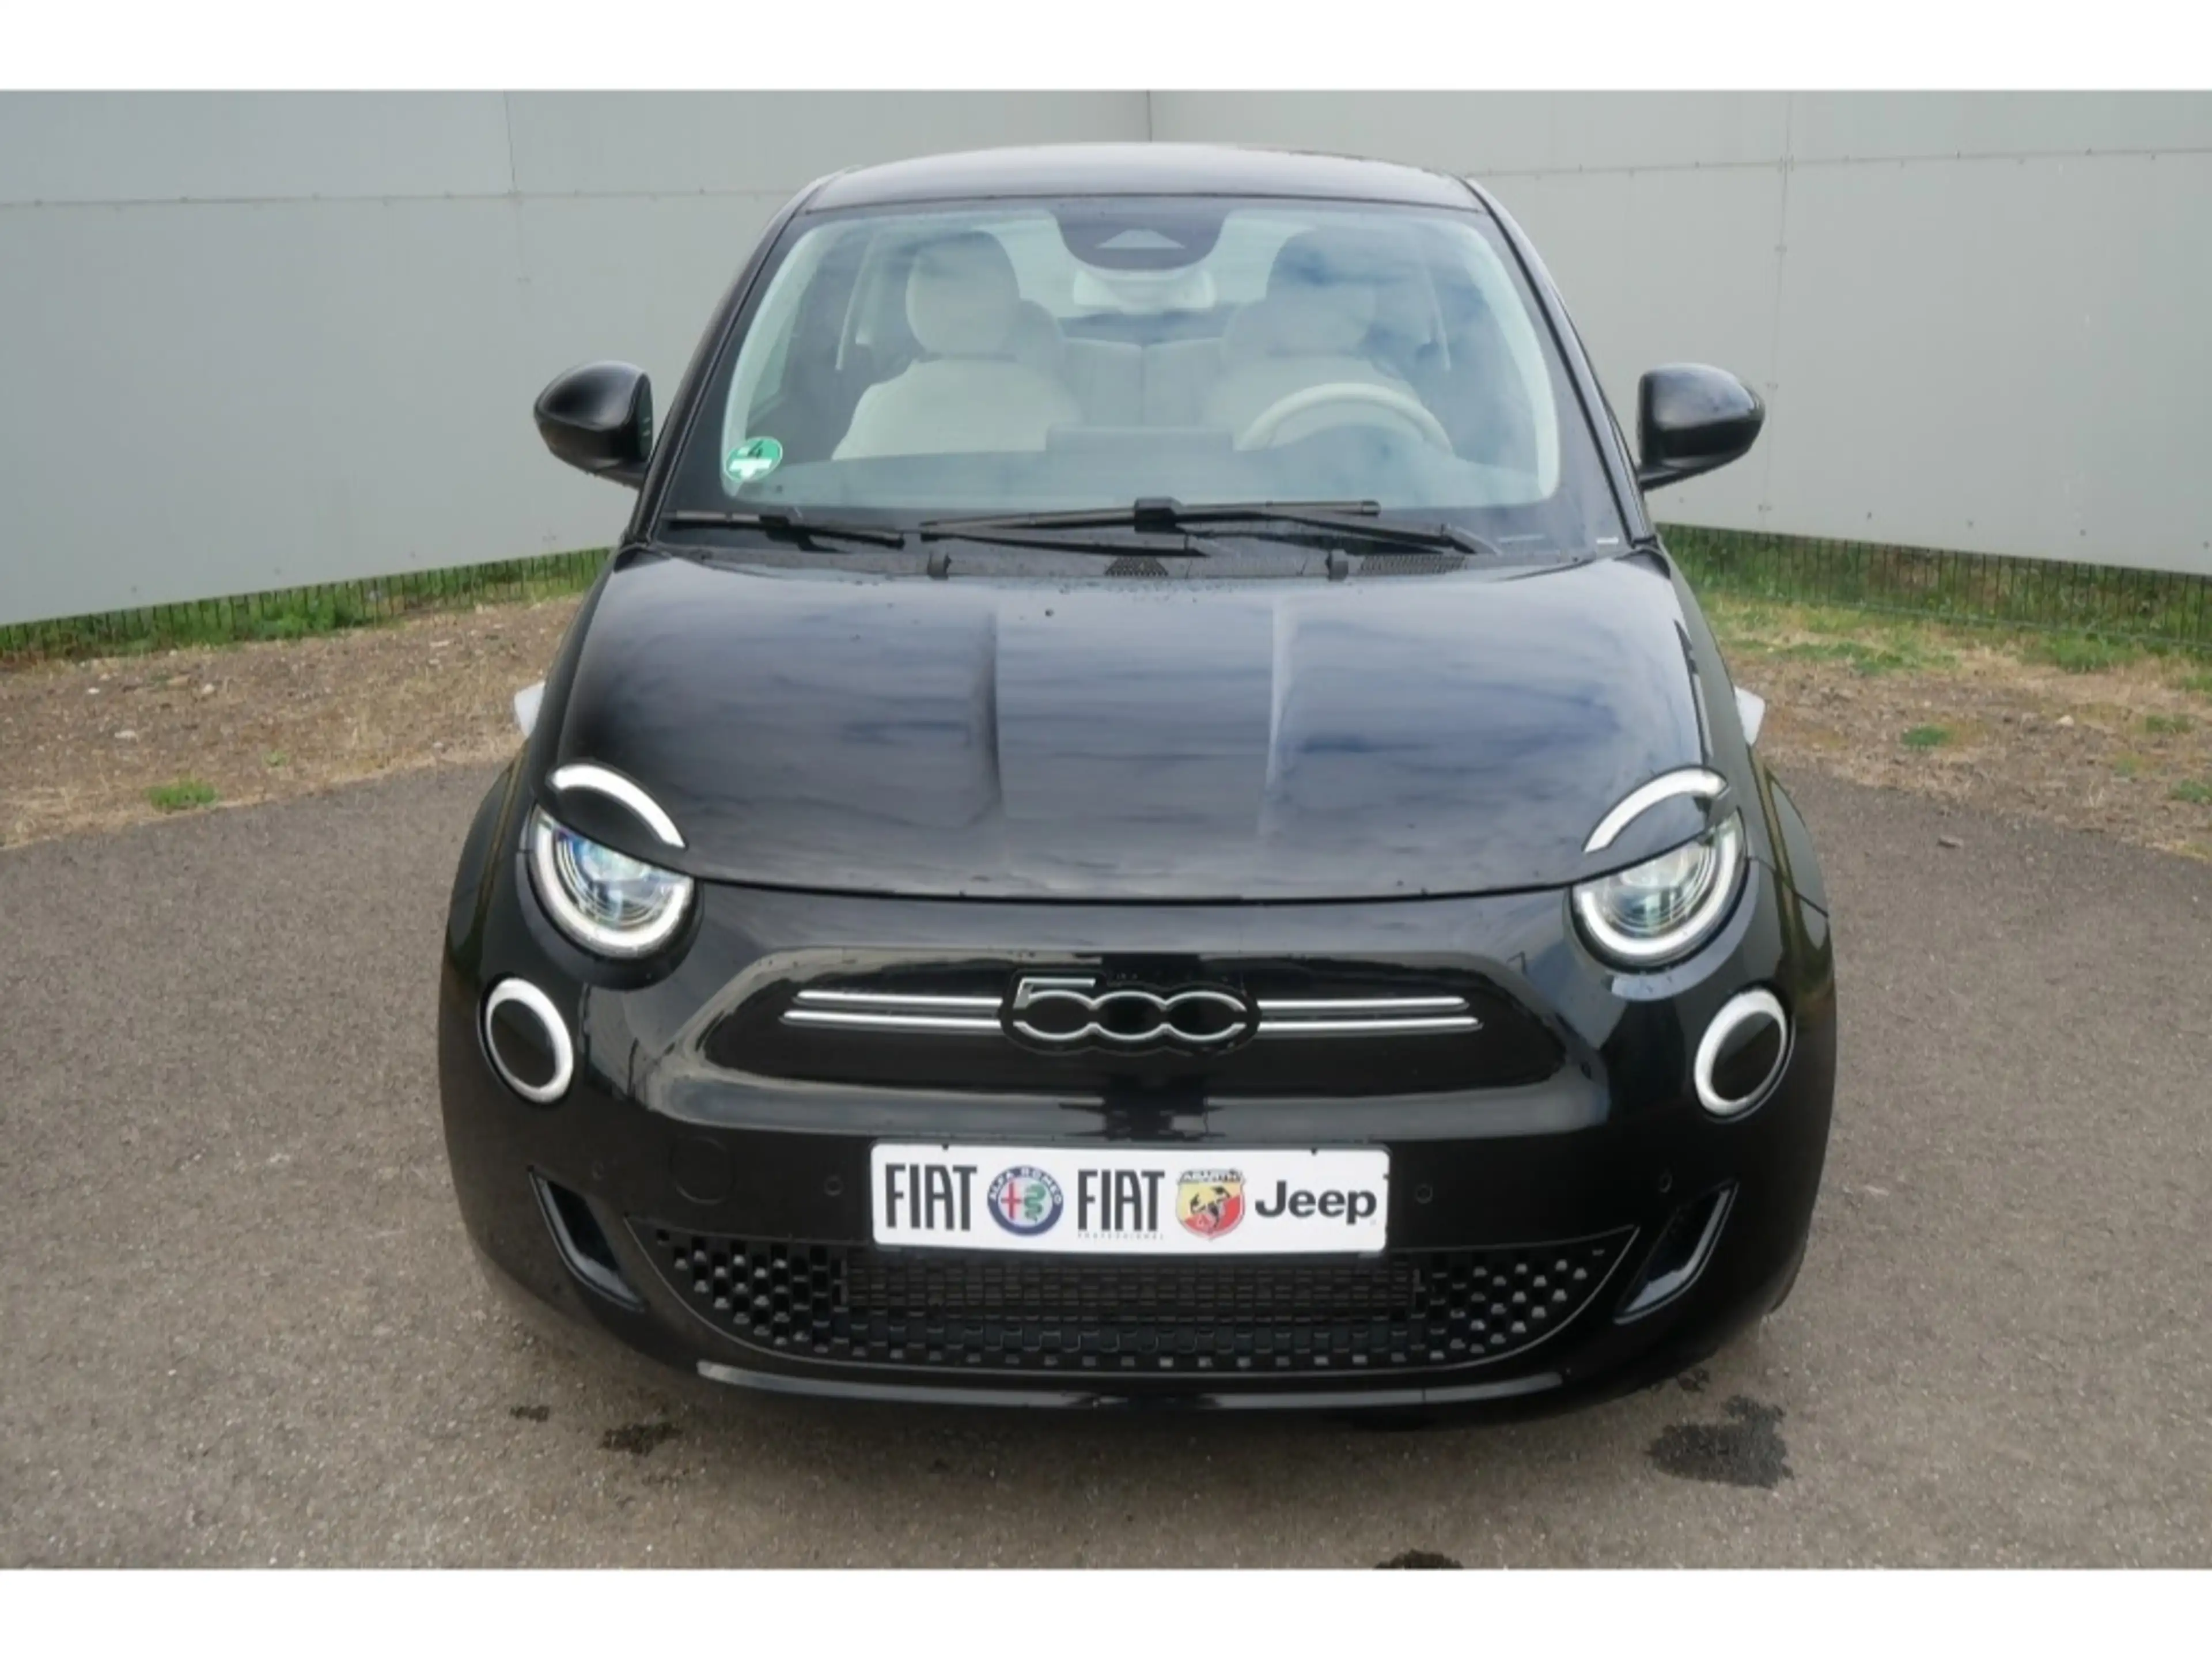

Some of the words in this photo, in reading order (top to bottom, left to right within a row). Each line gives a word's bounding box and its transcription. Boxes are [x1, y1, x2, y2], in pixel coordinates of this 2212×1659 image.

[747, 440, 763, 459] 4
[1013, 977, 1247, 1041] 500
[885, 1164, 978, 1231] FIAT
[1078, 1169, 1165, 1232] FIAT
[1255, 1180, 1377, 1225] Jeep
